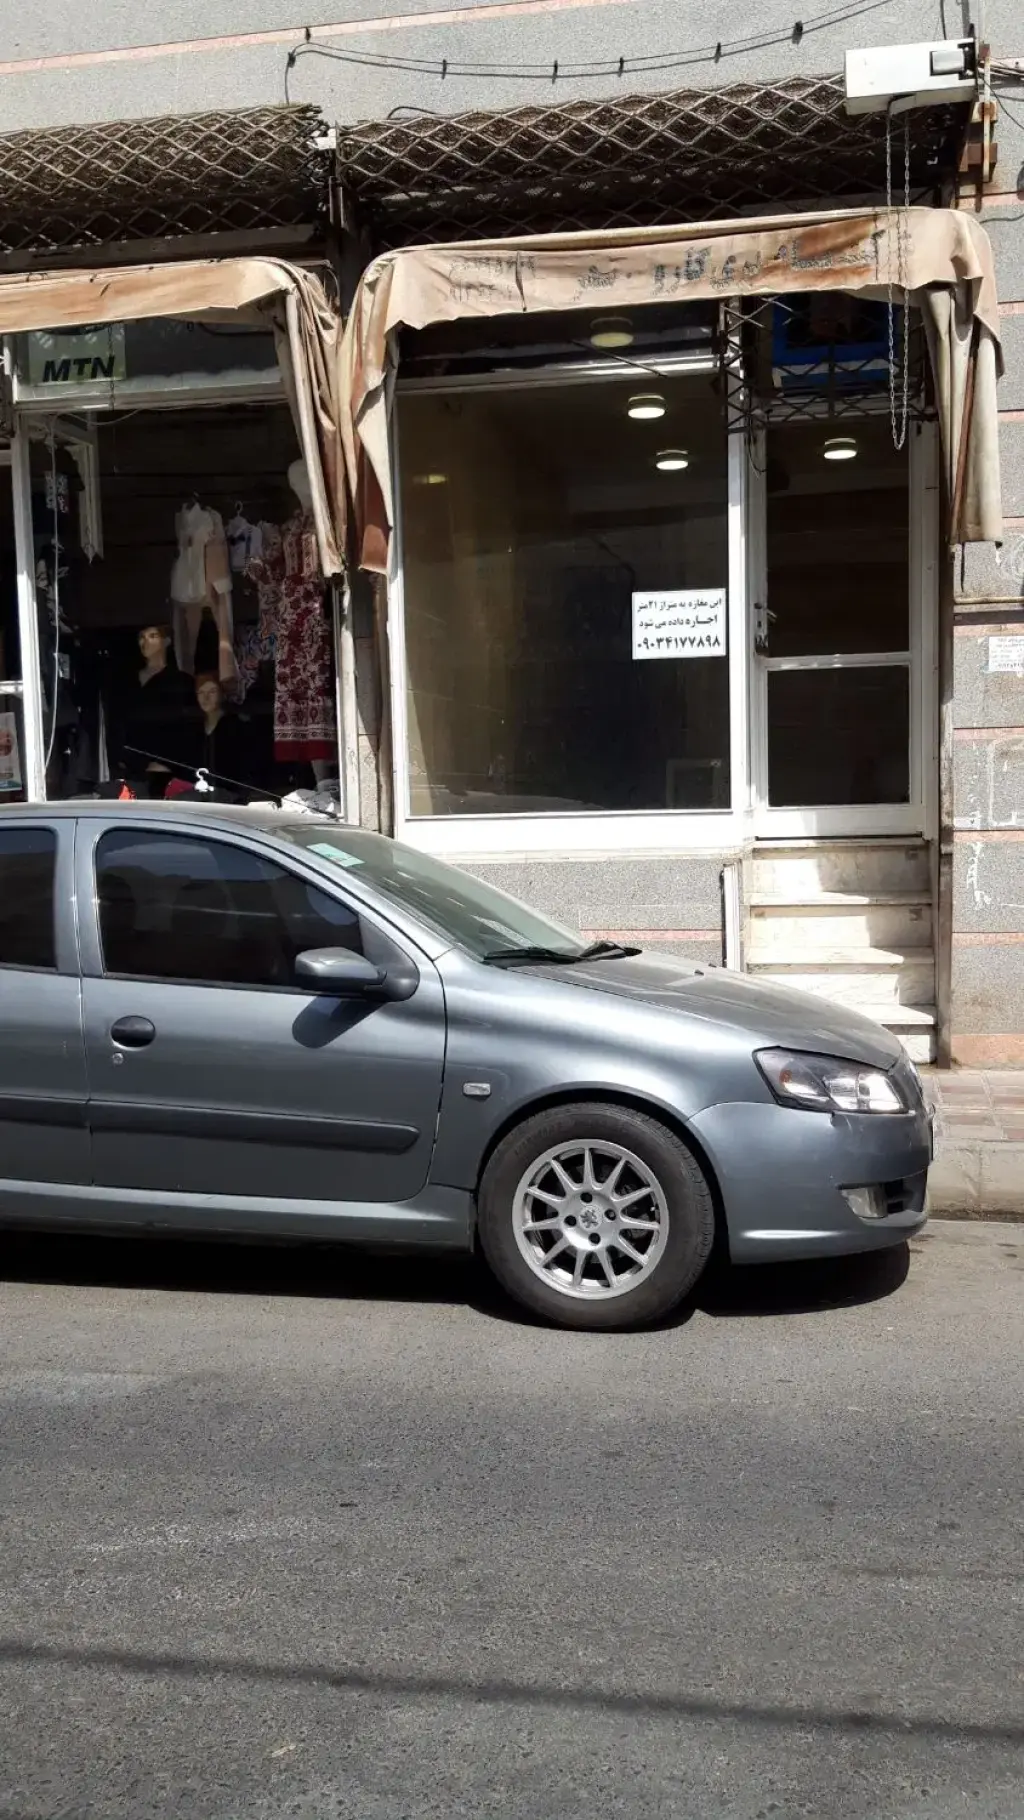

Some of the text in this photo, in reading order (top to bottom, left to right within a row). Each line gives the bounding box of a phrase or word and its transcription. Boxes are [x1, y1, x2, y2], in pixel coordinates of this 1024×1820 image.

[43, 354, 115, 382] MTN
[685, 614, 718, 628] اجاره
[637, 634, 721, 650] ۰۹۰۳۴۱۷۷۸۹۸
